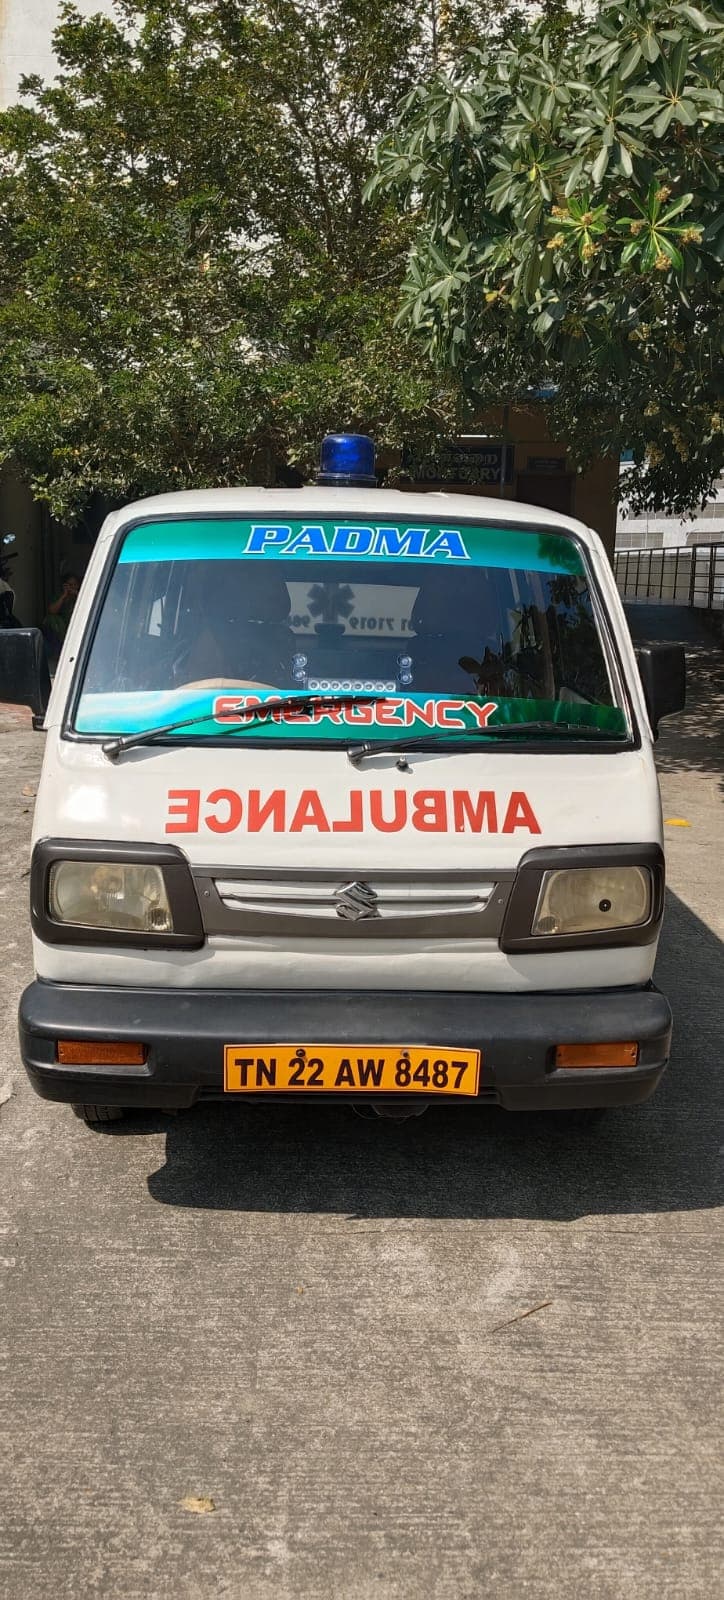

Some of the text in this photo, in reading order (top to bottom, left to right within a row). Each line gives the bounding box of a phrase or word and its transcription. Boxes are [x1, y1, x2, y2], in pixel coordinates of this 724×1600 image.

[242, 525, 471, 559] PADMA
[213, 695, 498, 729] EMERGENCY
[234, 1058, 468, 1088] TN 22 AW 8487
